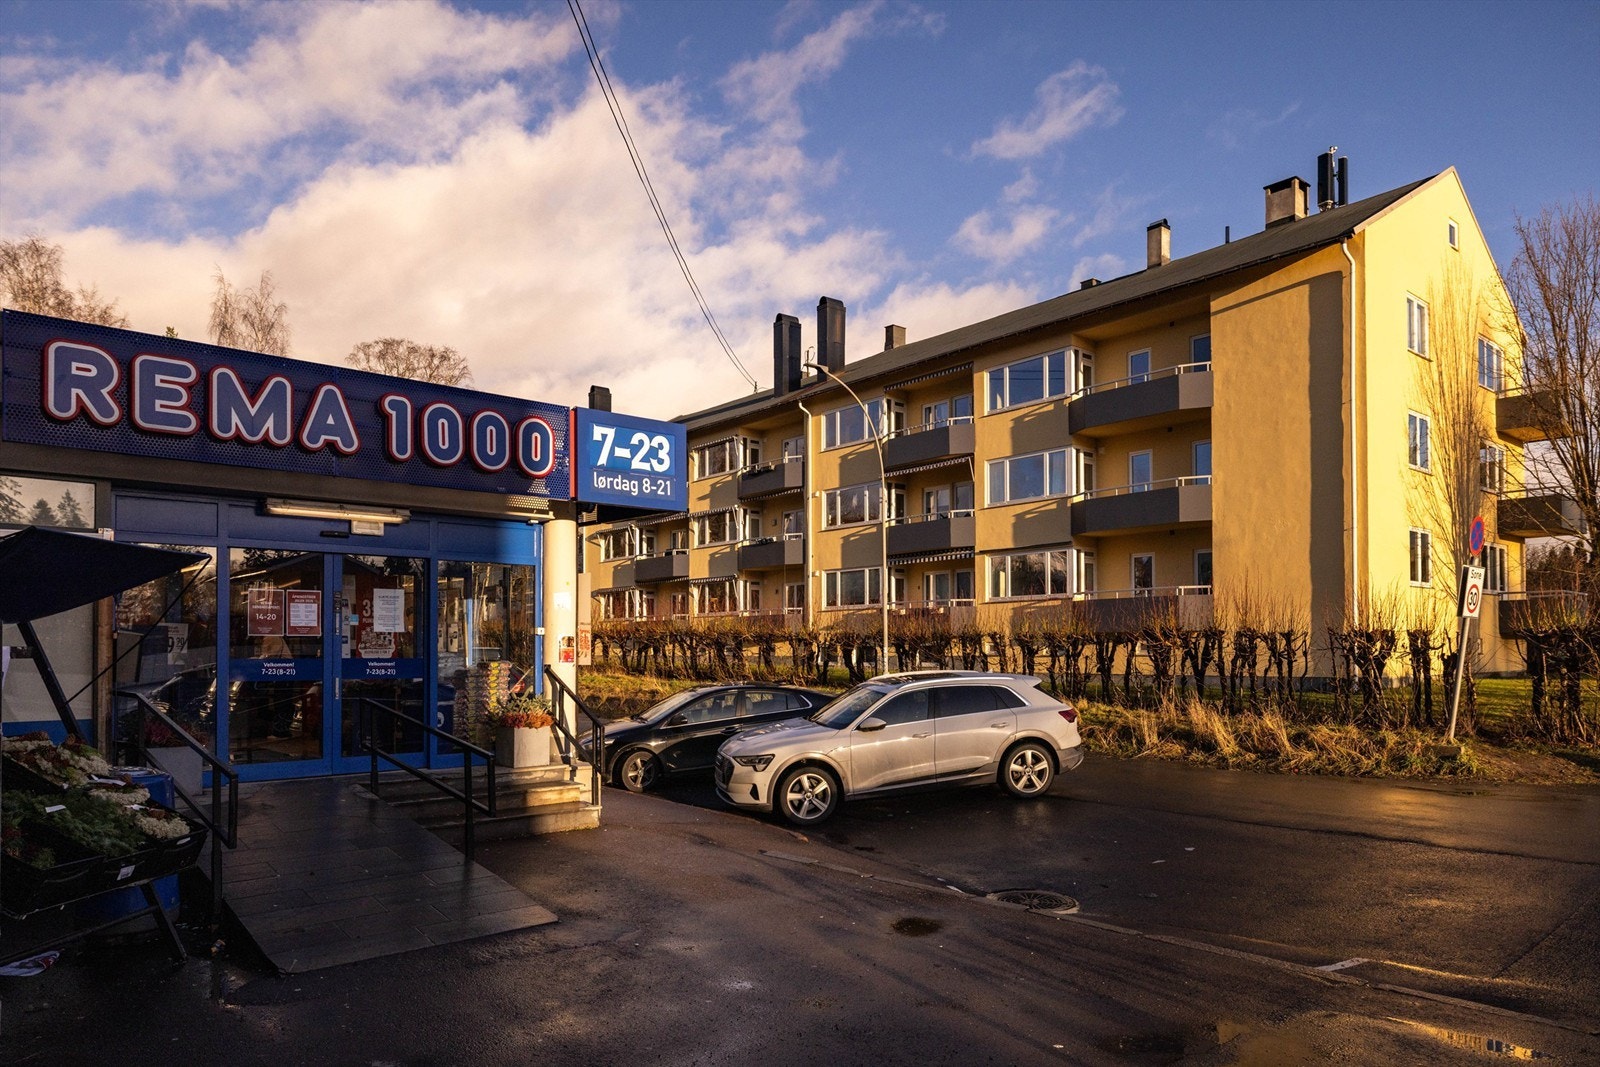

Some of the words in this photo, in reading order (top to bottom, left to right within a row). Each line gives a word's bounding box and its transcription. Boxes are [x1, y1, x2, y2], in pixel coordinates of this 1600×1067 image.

[43, 338, 361, 455] REMA
[380, 393, 555, 478] 1000
[592, 424, 671, 472] 7-23
[593, 472, 639, 496] lørdag
[642, 478, 671, 496] 8-21
[1470, 569, 1482, 580] Sone
[1468, 591, 1478, 606] 30
